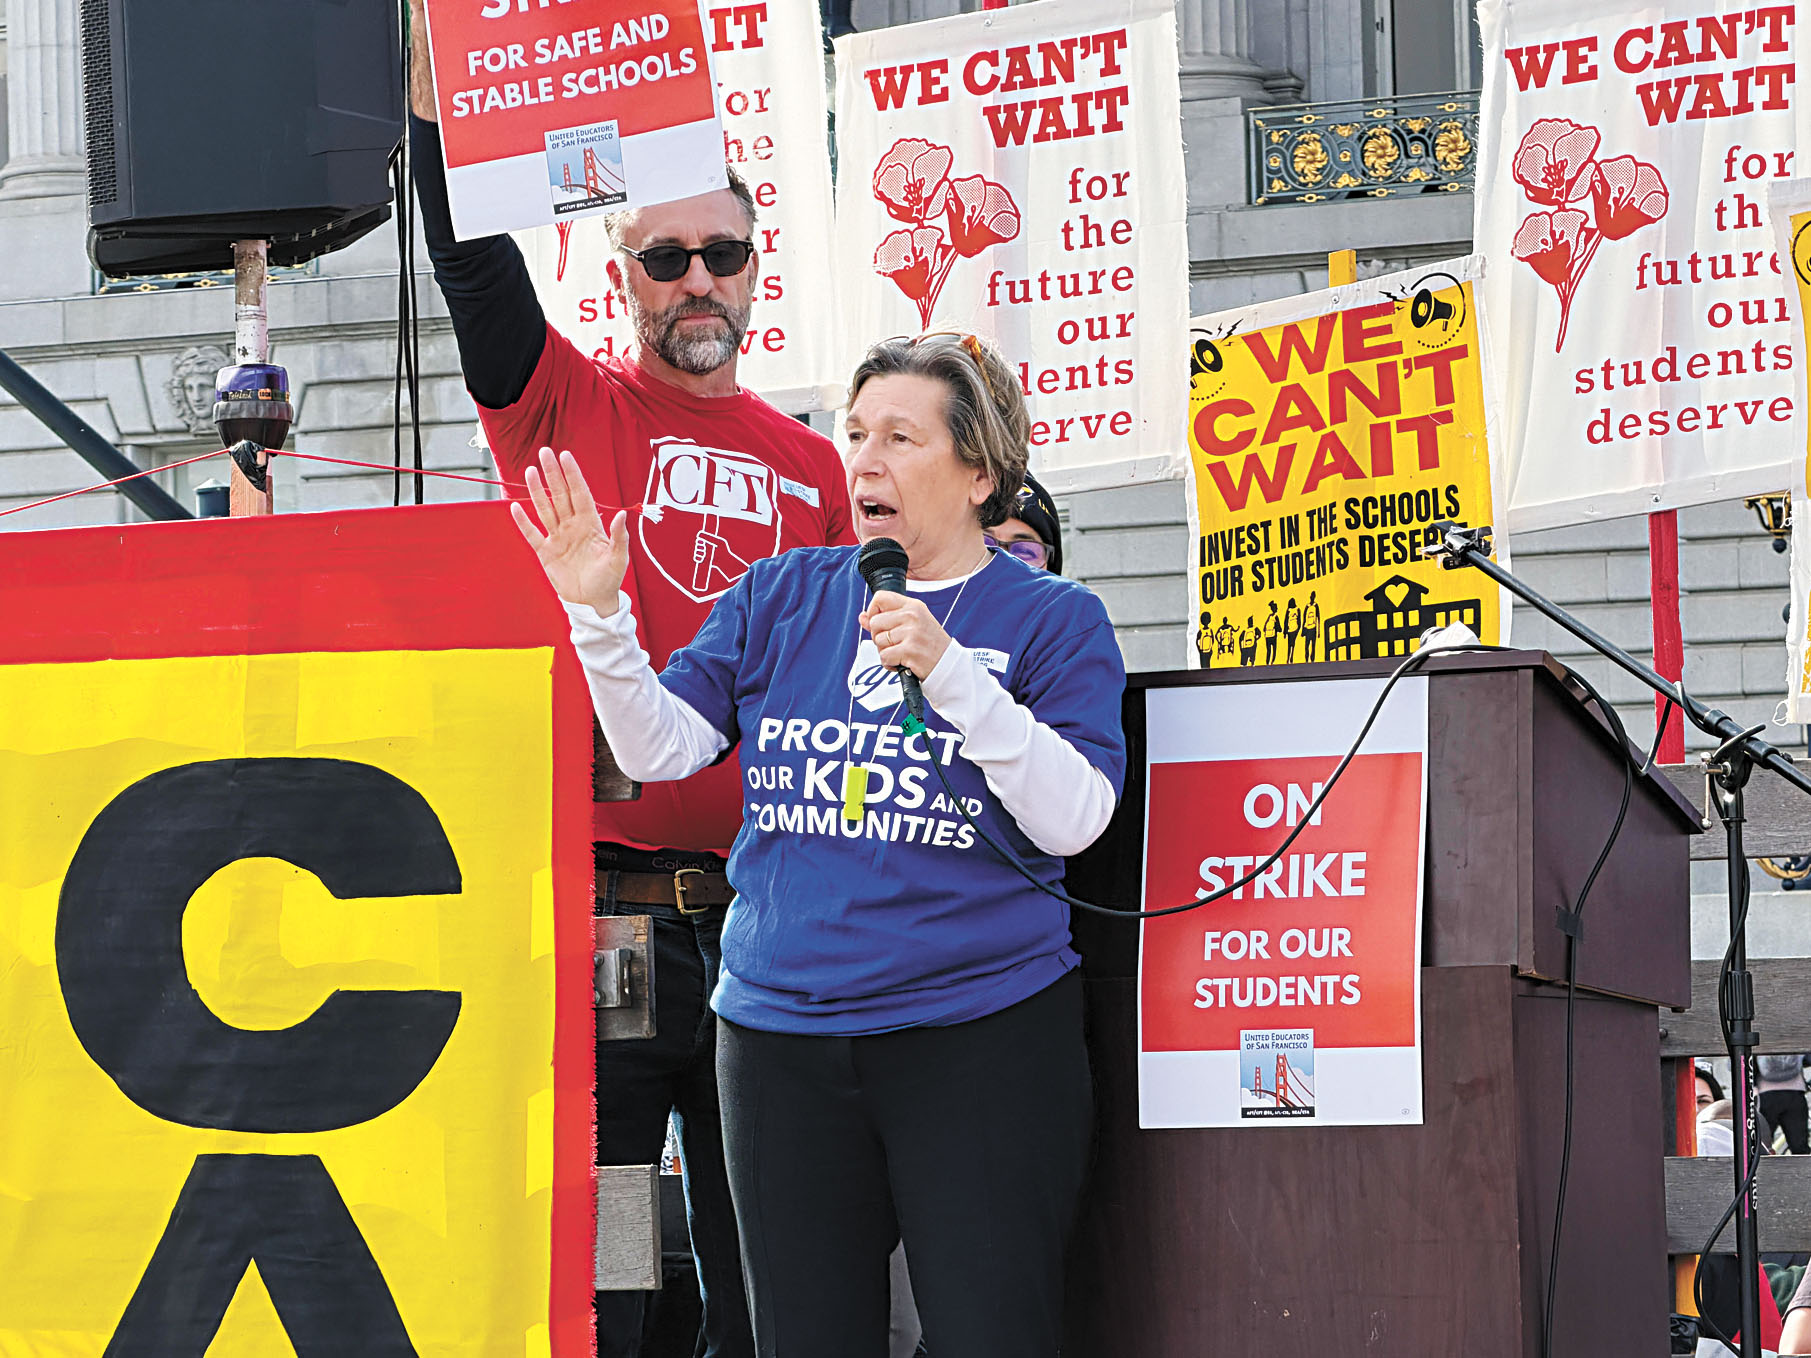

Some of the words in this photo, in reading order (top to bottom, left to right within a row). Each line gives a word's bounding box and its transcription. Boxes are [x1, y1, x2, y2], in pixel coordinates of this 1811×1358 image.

[468, 44, 528, 76] FOR
[534, 27, 604, 64] SAFE
[610, 14, 670, 50] AND
[709, 2, 767, 52] IT
[1505, 36, 1598, 92] WE
[1614, 5, 1795, 74] CAN'T
[452, 77, 554, 117] STABLE
[562, 48, 697, 98] SCHOOLS
[864, 58, 949, 112] WE
[963, 28, 1128, 96] CAN'T
[719, 83, 771, 116] or
[982, 85, 1129, 148] WAIT
[1636, 63, 1795, 127] WAIT
[723, 130, 774, 163] he
[1723, 145, 1794, 183] for
[1069, 168, 1130, 204] for
[1061, 215, 1132, 251] the
[1715, 193, 1762, 231] th
[987, 265, 1134, 307] future
[1058, 312, 1134, 345] our
[1707, 297, 1791, 329] our
[1241, 301, 1403, 384] WE
[1575, 339, 1793, 394] students
[1018, 355, 1134, 396] dents
[1193, 344, 1469, 457] CAN'T
[1587, 396, 1794, 445] deserve
[1029, 411, 1132, 446] erve
[661, 454, 763, 515] CFT
[1207, 408, 1454, 512] WAIT
[1200, 520, 1272, 567] INVEST
[1280, 513, 1300, 549] IN
[1306, 501, 1338, 542] THE
[1344, 484, 1460, 530] SCHOOLS
[1201, 564, 1244, 604] OUR
[1251, 537, 1349, 592] STUDENTS
[1359, 522, 1467, 567] DESER
[758, 717, 965, 766] PROTECT
[747, 766, 794, 790] OUR
[803, 758, 929, 809] KIDS
[930, 792, 984, 817] AND
[1243, 782, 1323, 828] ON
[652, 857, 700, 869] Calvin
[1195, 852, 1366, 900] STRIKE
[1204, 930, 1272, 961] FOR
[1280, 927, 1353, 959] OUR
[1194, 974, 1361, 1009] STUDENTS
